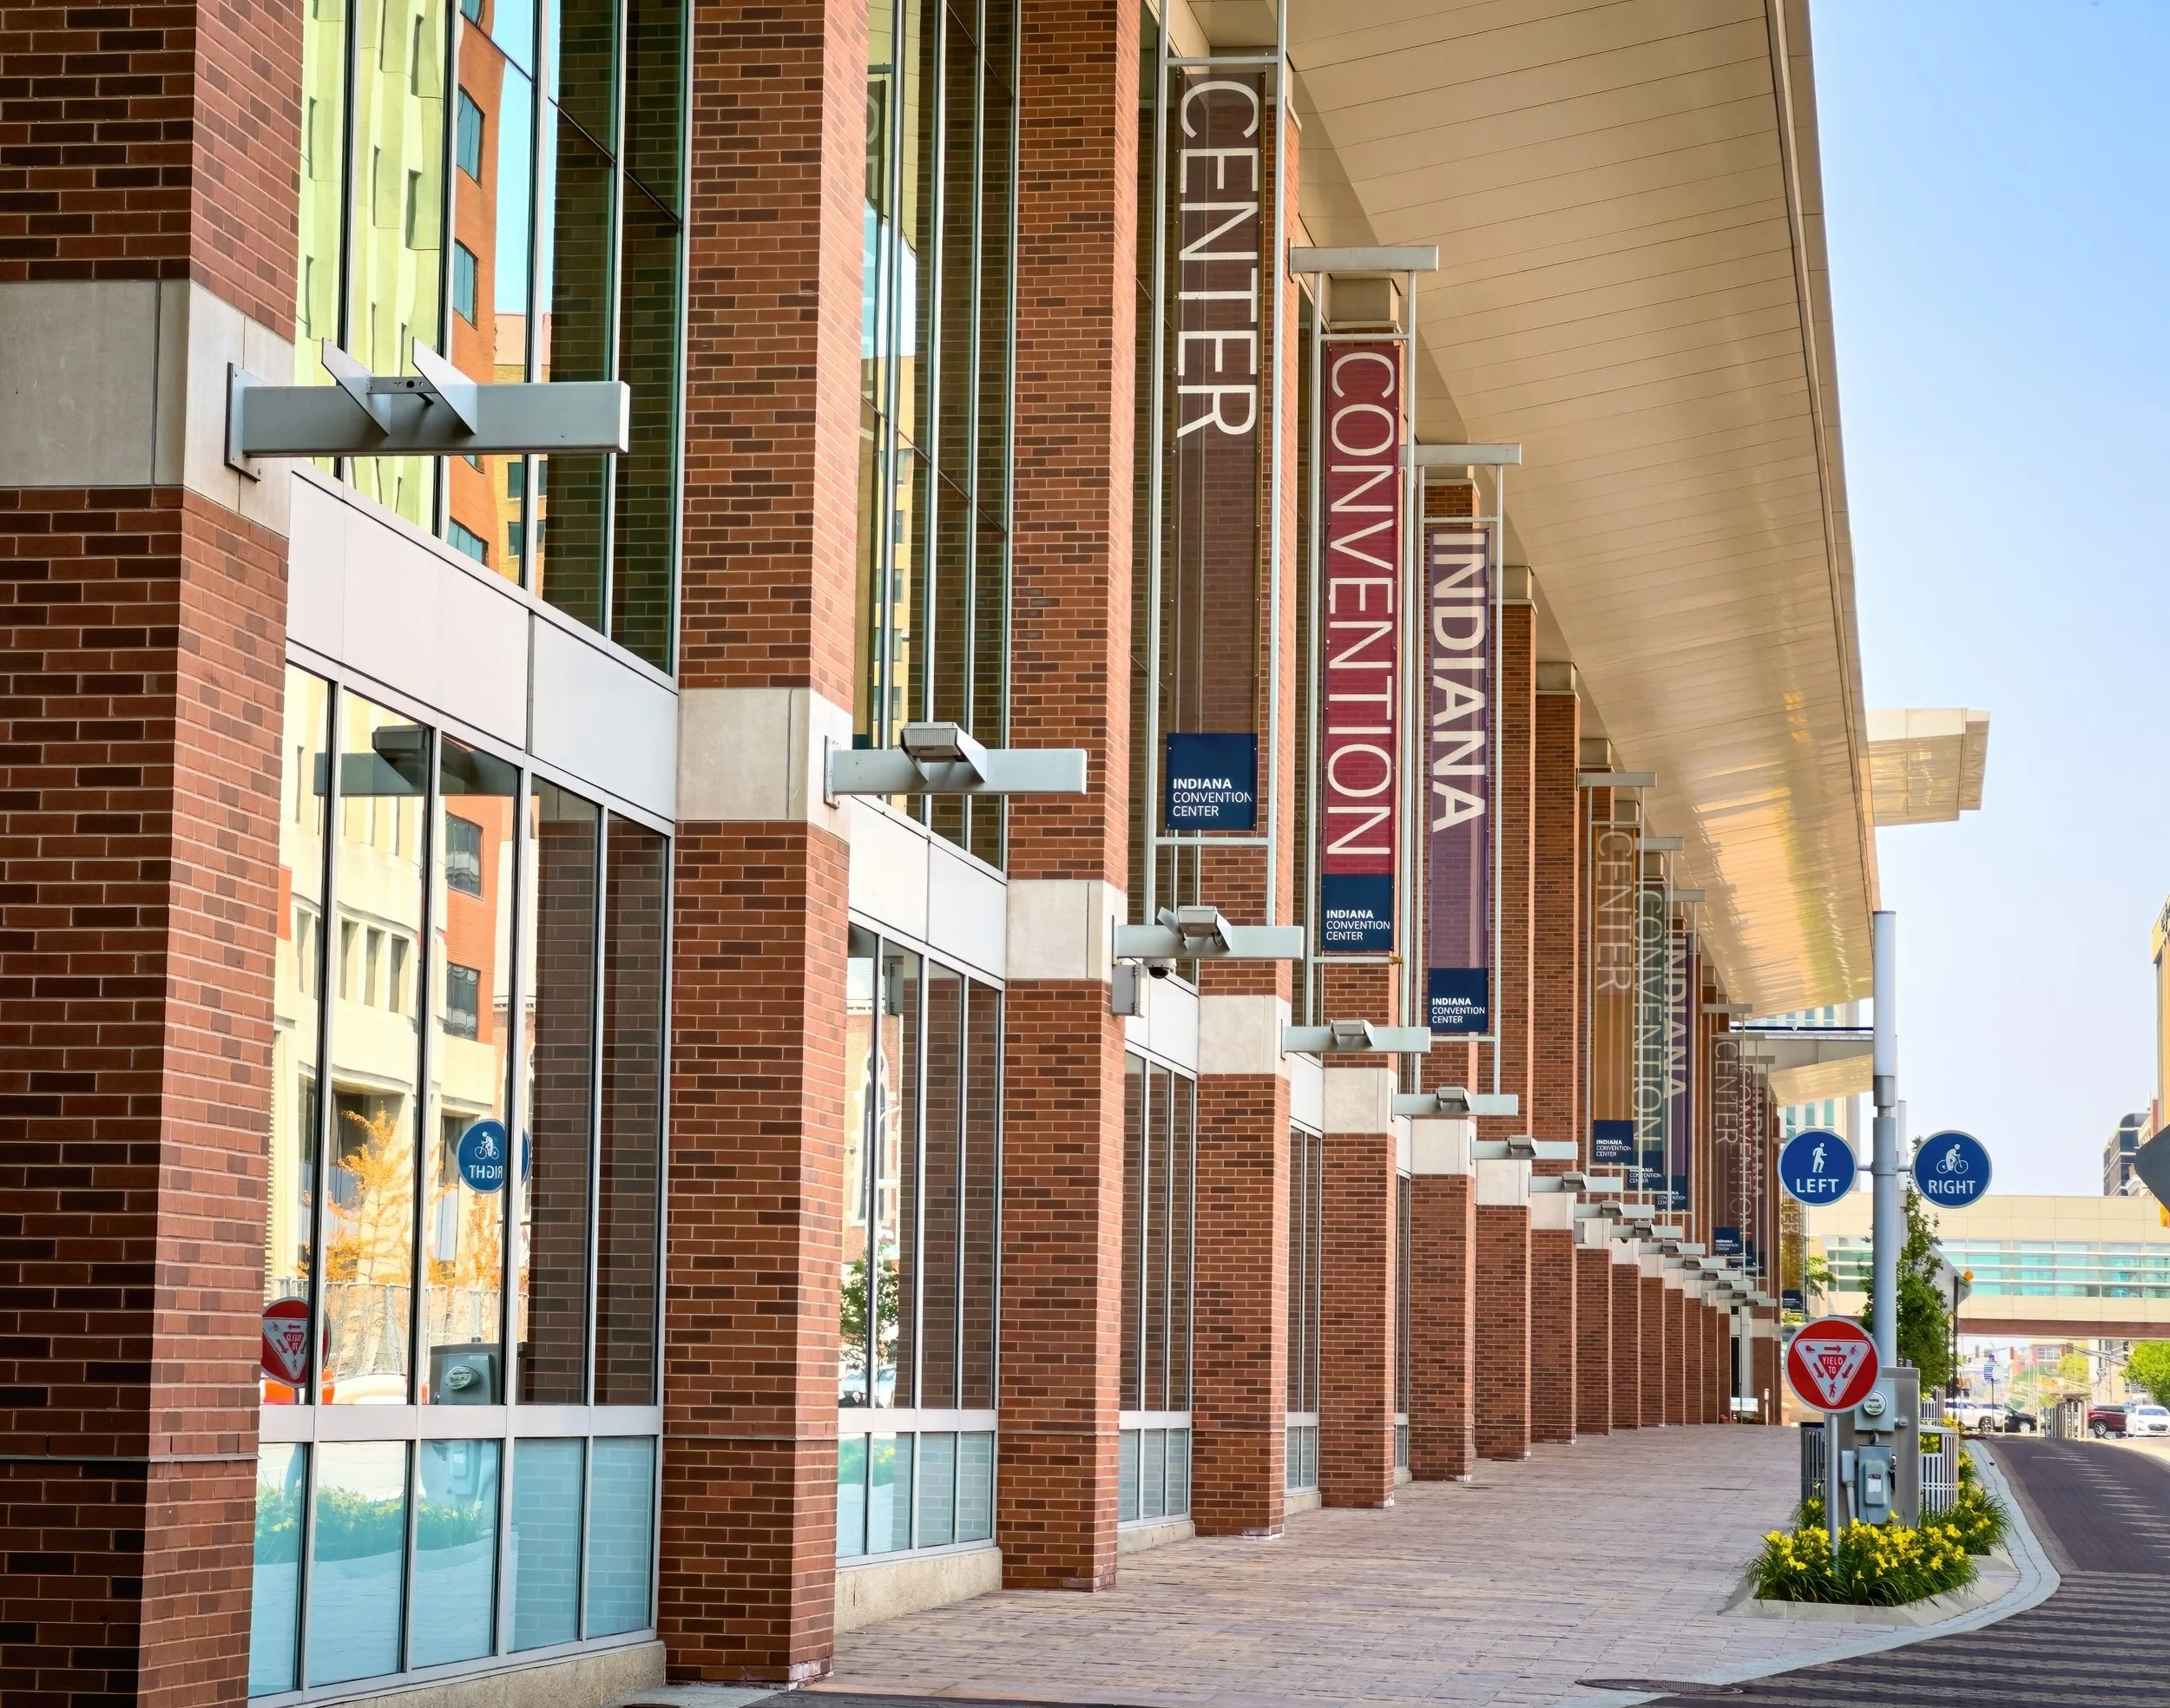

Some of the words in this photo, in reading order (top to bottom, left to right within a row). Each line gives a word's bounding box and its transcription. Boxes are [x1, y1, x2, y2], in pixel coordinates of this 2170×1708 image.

[1176, 80, 1259, 438] CENTER
[1326, 351, 1395, 855] CONVENTION
[1432, 532, 1487, 832] INDIANA
[1173, 778, 1233, 790] INDIANA
[1173, 792, 1253, 804] CONVENTION
[1173, 805, 1220, 817] CENTER
[1326, 910, 1374, 919] INDIANA
[1597, 831, 1633, 990] CENTER
[1325, 920, 1391, 930] CONVENTION
[1325, 931, 1364, 941] CENTER
[1432, 997, 1472, 1006] INDIANA
[1715, 1041, 1738, 1144] CENTER
[1796, 1179, 1839, 1193] LEFT
[1928, 1179, 1976, 1194] RIGHT
[1822, 1357, 1844, 1365] YIELD
[1828, 1366, 1837, 1375] TO
